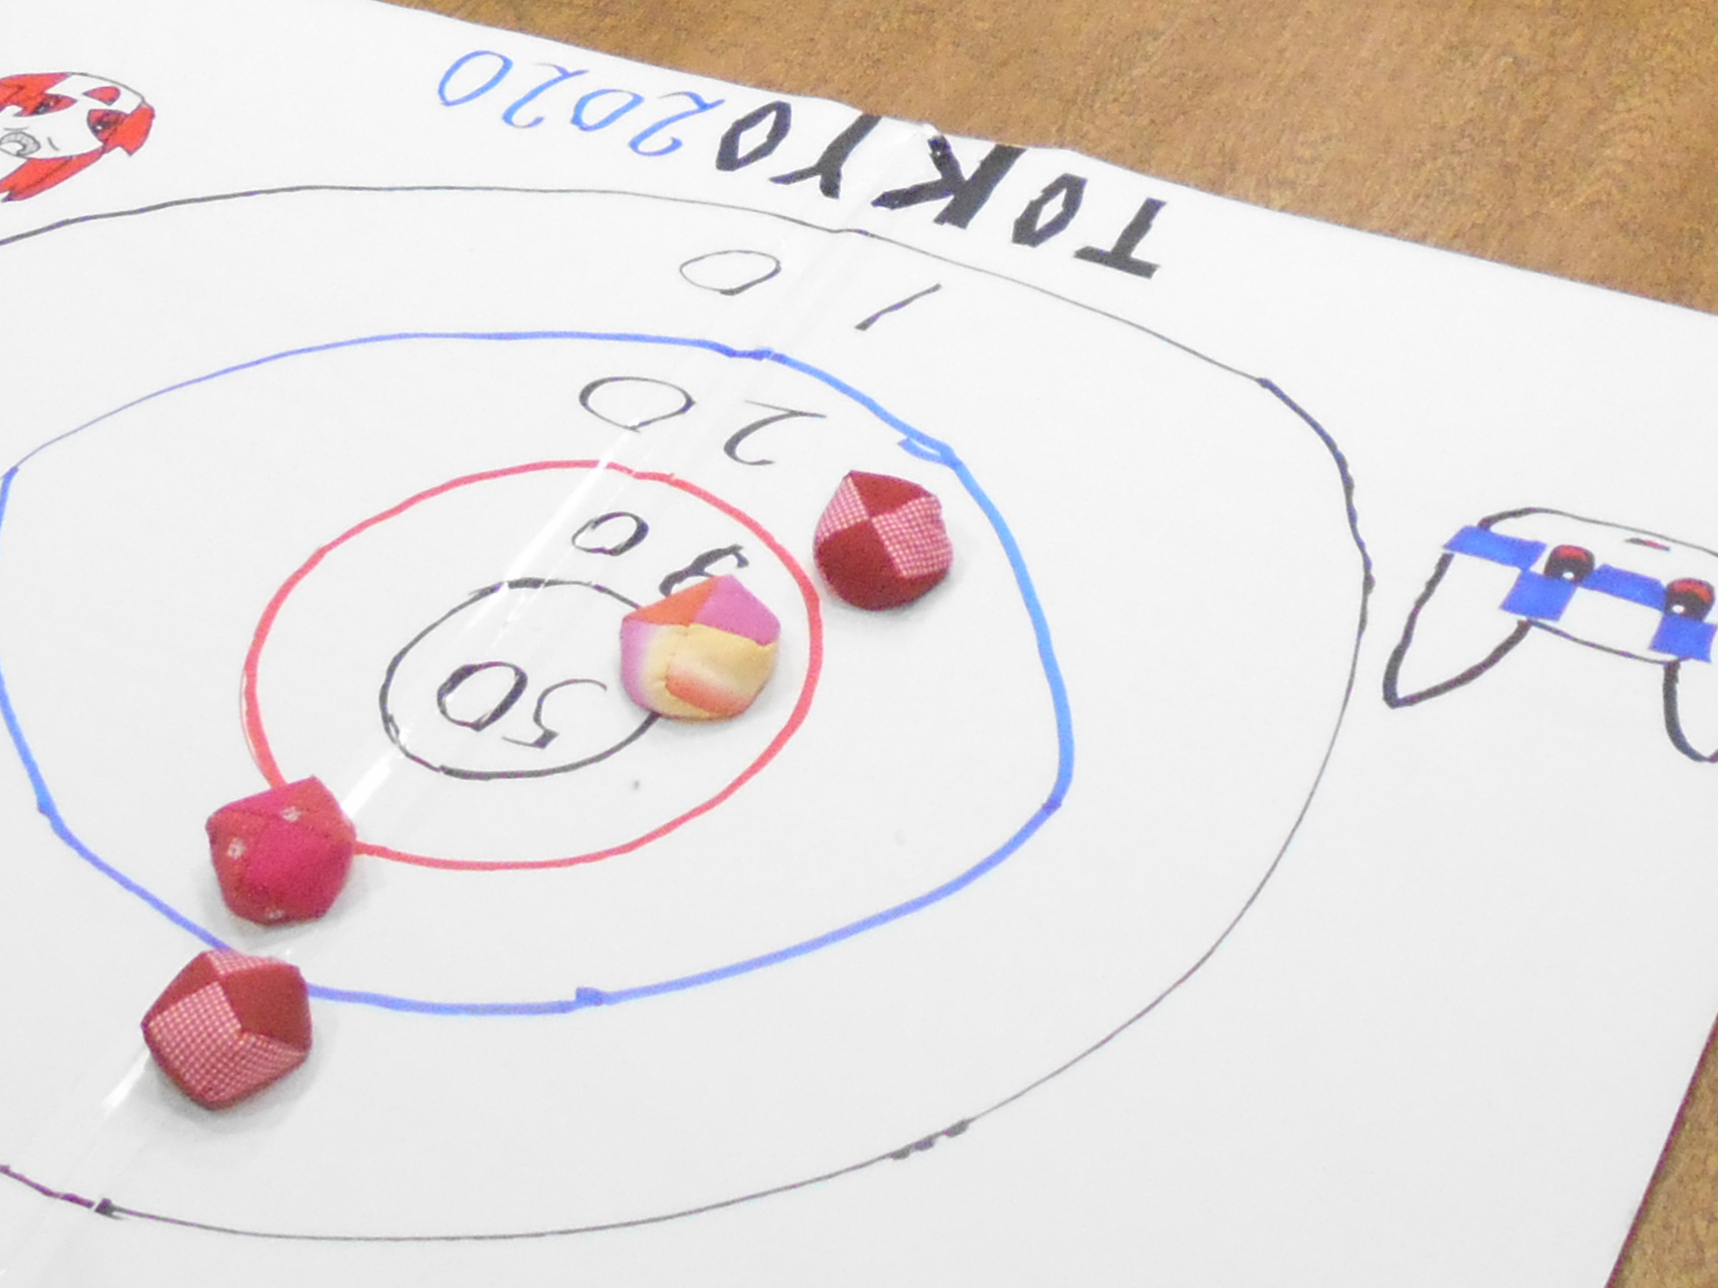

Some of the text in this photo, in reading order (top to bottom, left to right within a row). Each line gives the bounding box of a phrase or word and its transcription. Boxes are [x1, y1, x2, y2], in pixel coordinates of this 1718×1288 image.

[437, 49, 1164, 279] TOKYO 2020
[678, 248, 943, 332] 10
[578, 375, 827, 467] 20
[436, 661, 608, 750] 50
